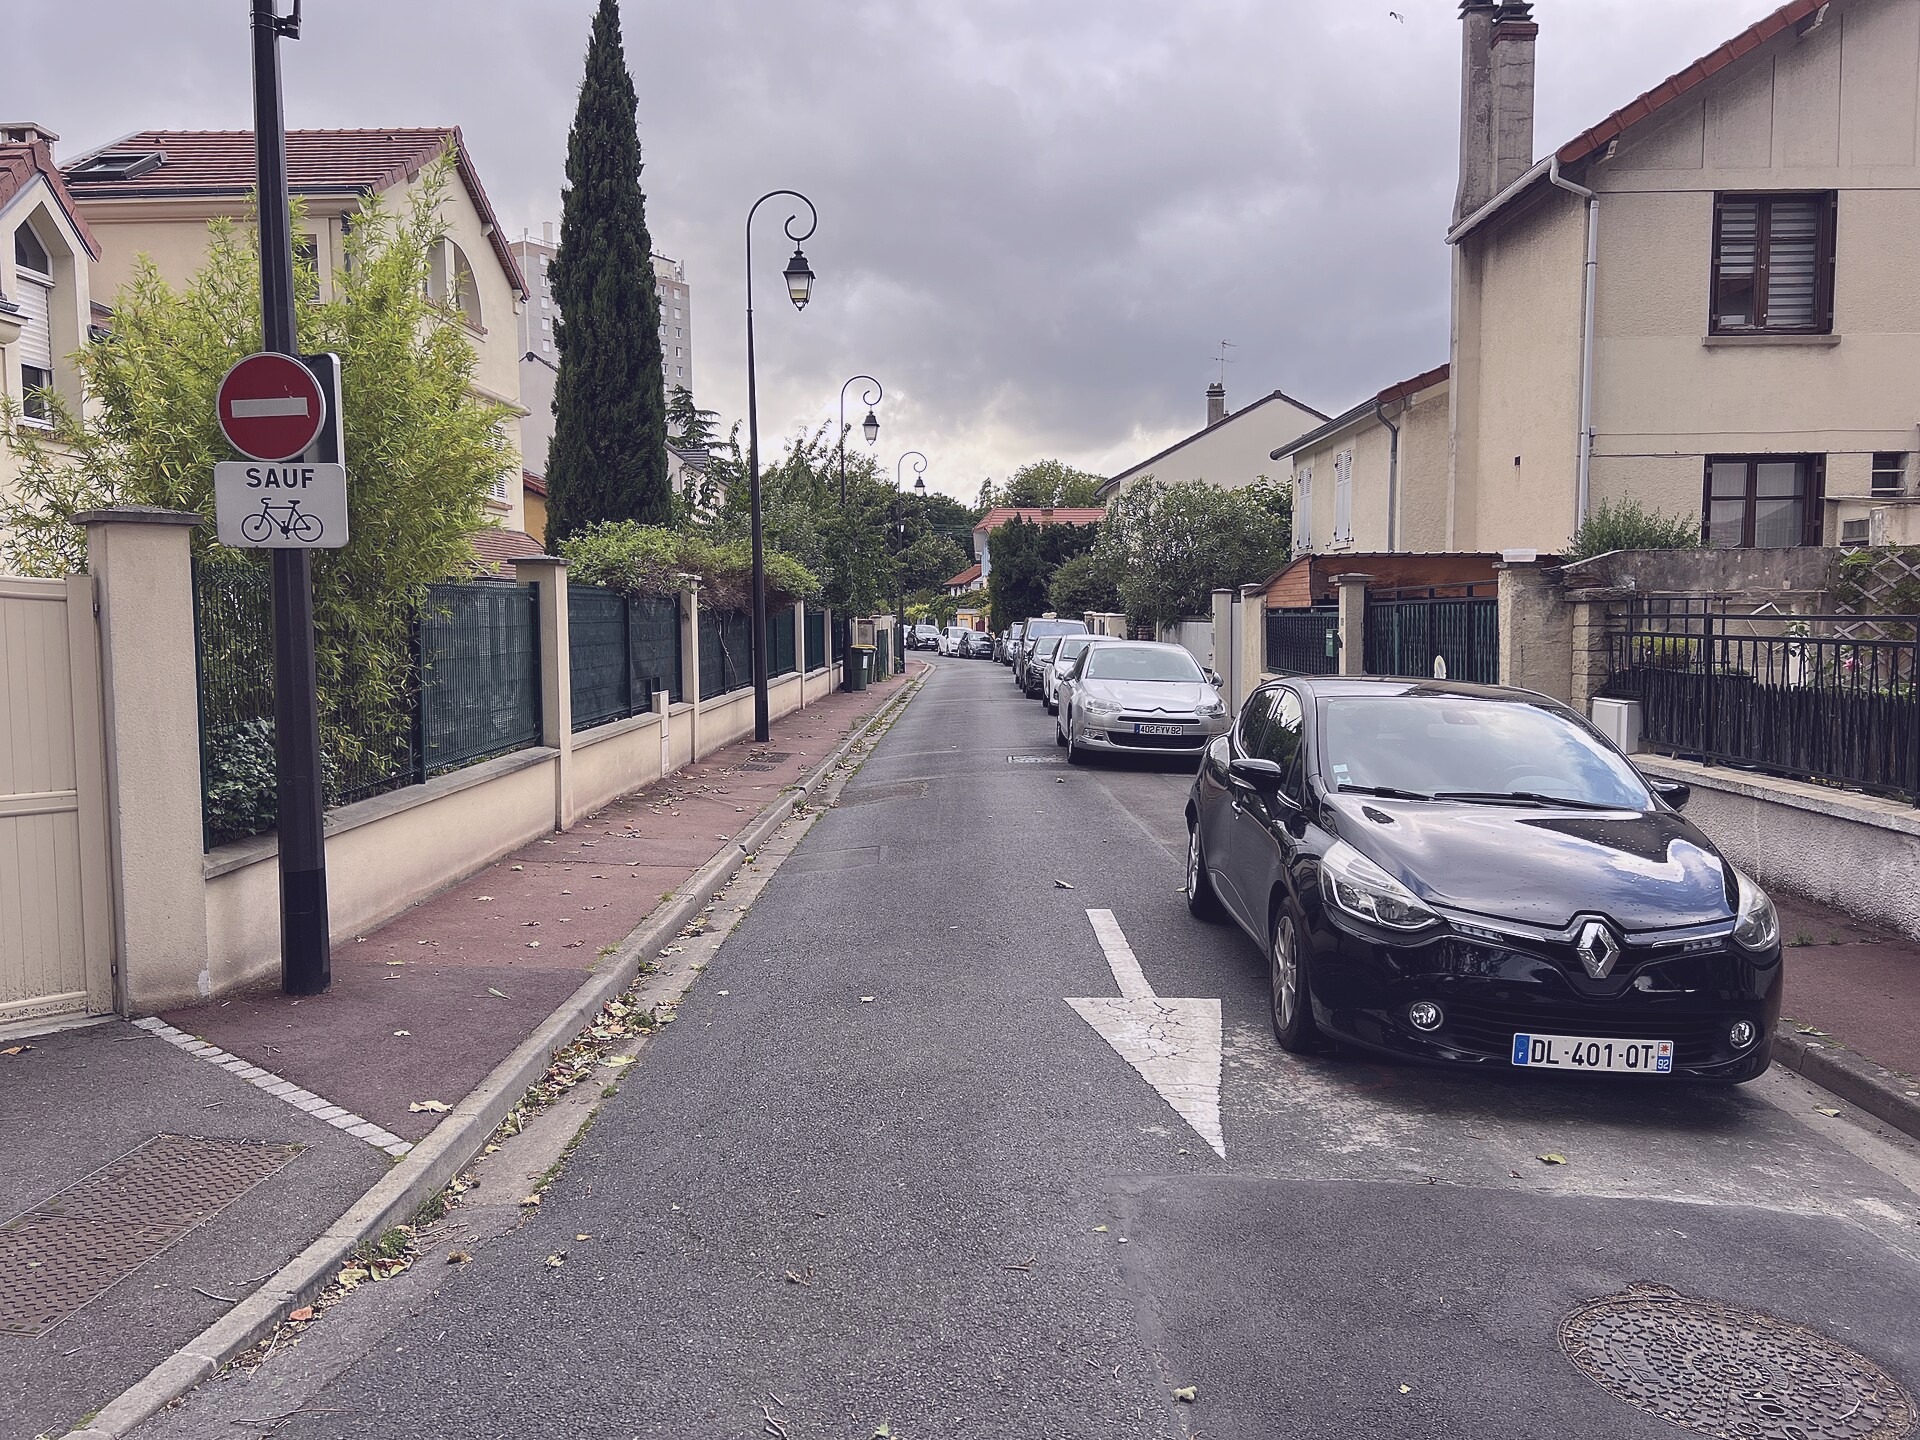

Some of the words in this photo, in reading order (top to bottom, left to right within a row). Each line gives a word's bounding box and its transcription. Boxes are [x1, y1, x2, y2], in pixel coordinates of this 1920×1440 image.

[246, 468, 315, 488] SAUF
[1518, 1052, 1524, 1060] F
[1657, 1059, 1669, 1070] 92
